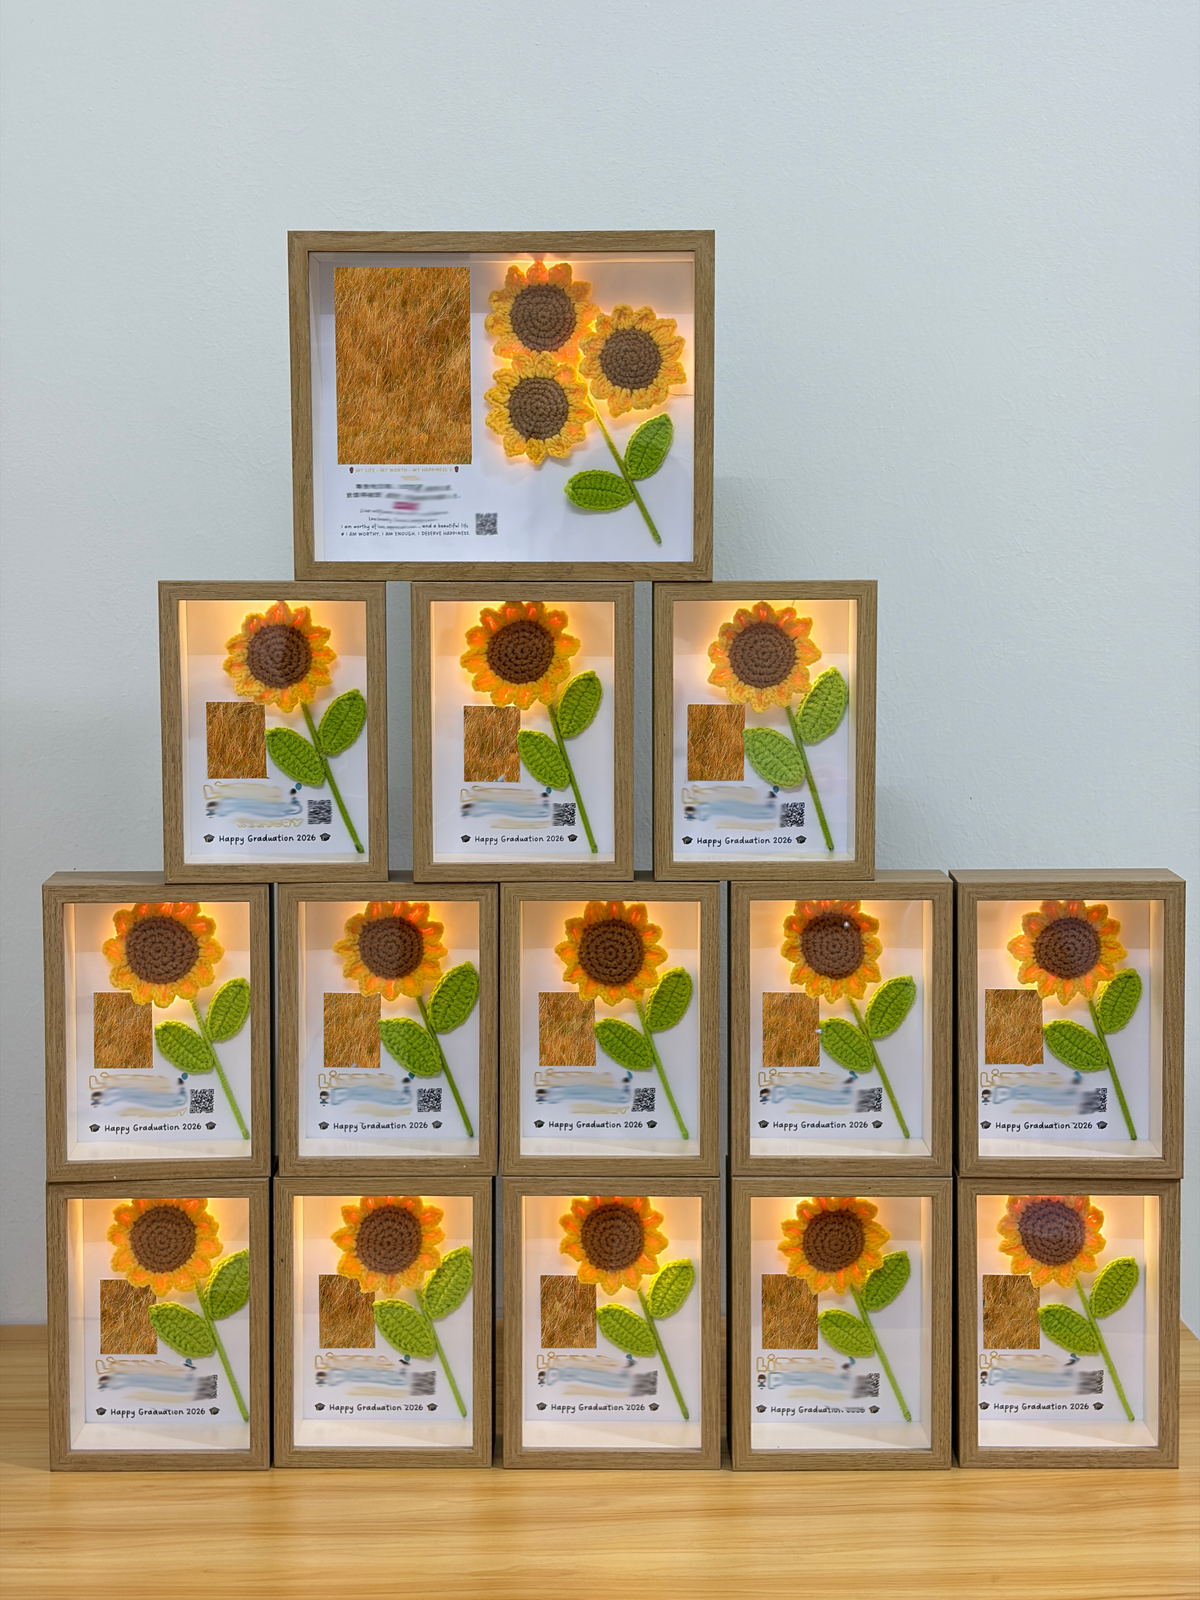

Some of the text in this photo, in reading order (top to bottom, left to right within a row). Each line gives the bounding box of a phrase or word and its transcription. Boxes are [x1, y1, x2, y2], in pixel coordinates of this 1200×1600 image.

[219, 834, 316, 845] Happy Graduation 2026
[475, 836, 498, 845] Happy
[546, 834, 564, 842] 2026
[697, 835, 792, 847] Happy Graduation 2026
[105, 1125, 130, 1134] Happy
[133, 1123, 179, 1131] Graduation
[333, 1123, 358, 1132] Happy
[409, 1121, 428, 1129] 2026
[549, 1121, 573, 1131] Happy
[576, 1120, 621, 1128] Graduation
[773, 1121, 797, 1131] Happy
[996, 1122, 1020, 1132] Happy
[1073, 1121, 1093, 1129] 2026
[329, 1404, 353, 1413] Happy
[357, 1403, 402, 1411] Graduation
[551, 1404, 575, 1413] Happy
[578, 1403, 623, 1411] Graduation
[771, 1406, 795, 1416] Happy
[994, 1403, 1018, 1412] Happy
[110, 1409, 135, 1418] Happy
